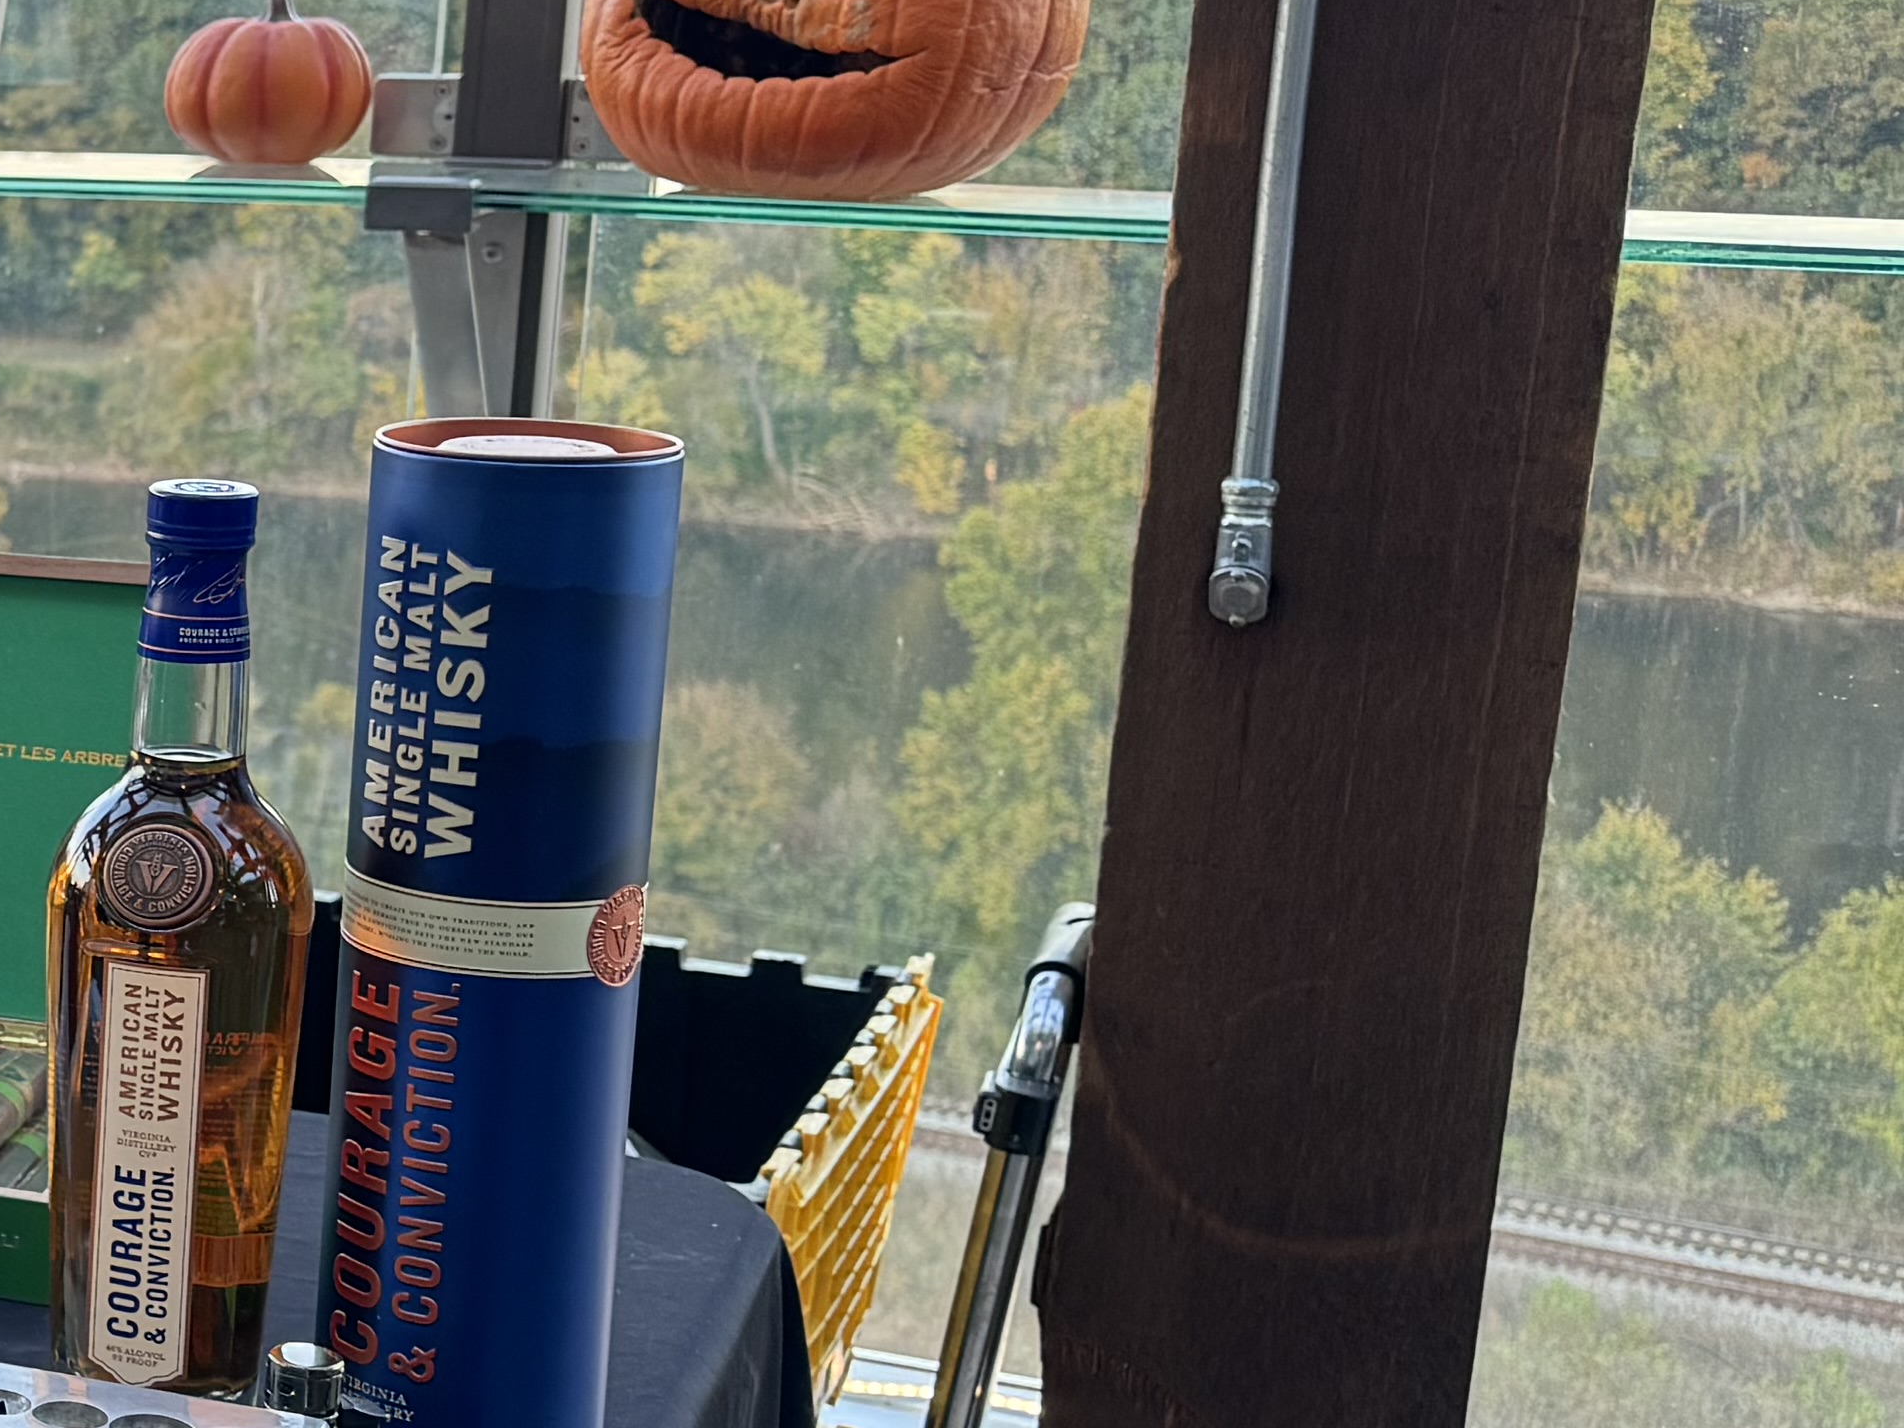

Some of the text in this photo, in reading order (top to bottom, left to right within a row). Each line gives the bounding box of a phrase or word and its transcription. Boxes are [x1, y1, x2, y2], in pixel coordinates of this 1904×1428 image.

[179, 626, 220, 638] COURAGE
[362, 534, 410, 851] AMERICAN
[390, 543, 440, 857] SINGLE MALT
[423, 547, 495, 860] WHISKY
[20, 744, 57, 763] LES
[113, 847, 135, 902] COURAGE
[132, 833, 190, 853] VIRGINIA
[148, 855, 198, 912] CONVICTION
[134, 898, 144, 910] &
[118, 983, 143, 1119] AMERICAN
[138, 986, 161, 1121] SINGLE MALT
[157, 988, 186, 1122] WHISKY
[116, 1137, 177, 1154] DISTILLERY
[121, 1129, 172, 1144] VIRGINIA
[329, 968, 402, 1366] COURAGE
[387, 980, 462, 1384] & CONVICTION.
[106, 1164, 147, 1340] COURAGE
[145, 1166, 175, 1319] CONVICTION.
[125, 1354, 159, 1368] PROOF
[144, 1327, 167, 1345] &
